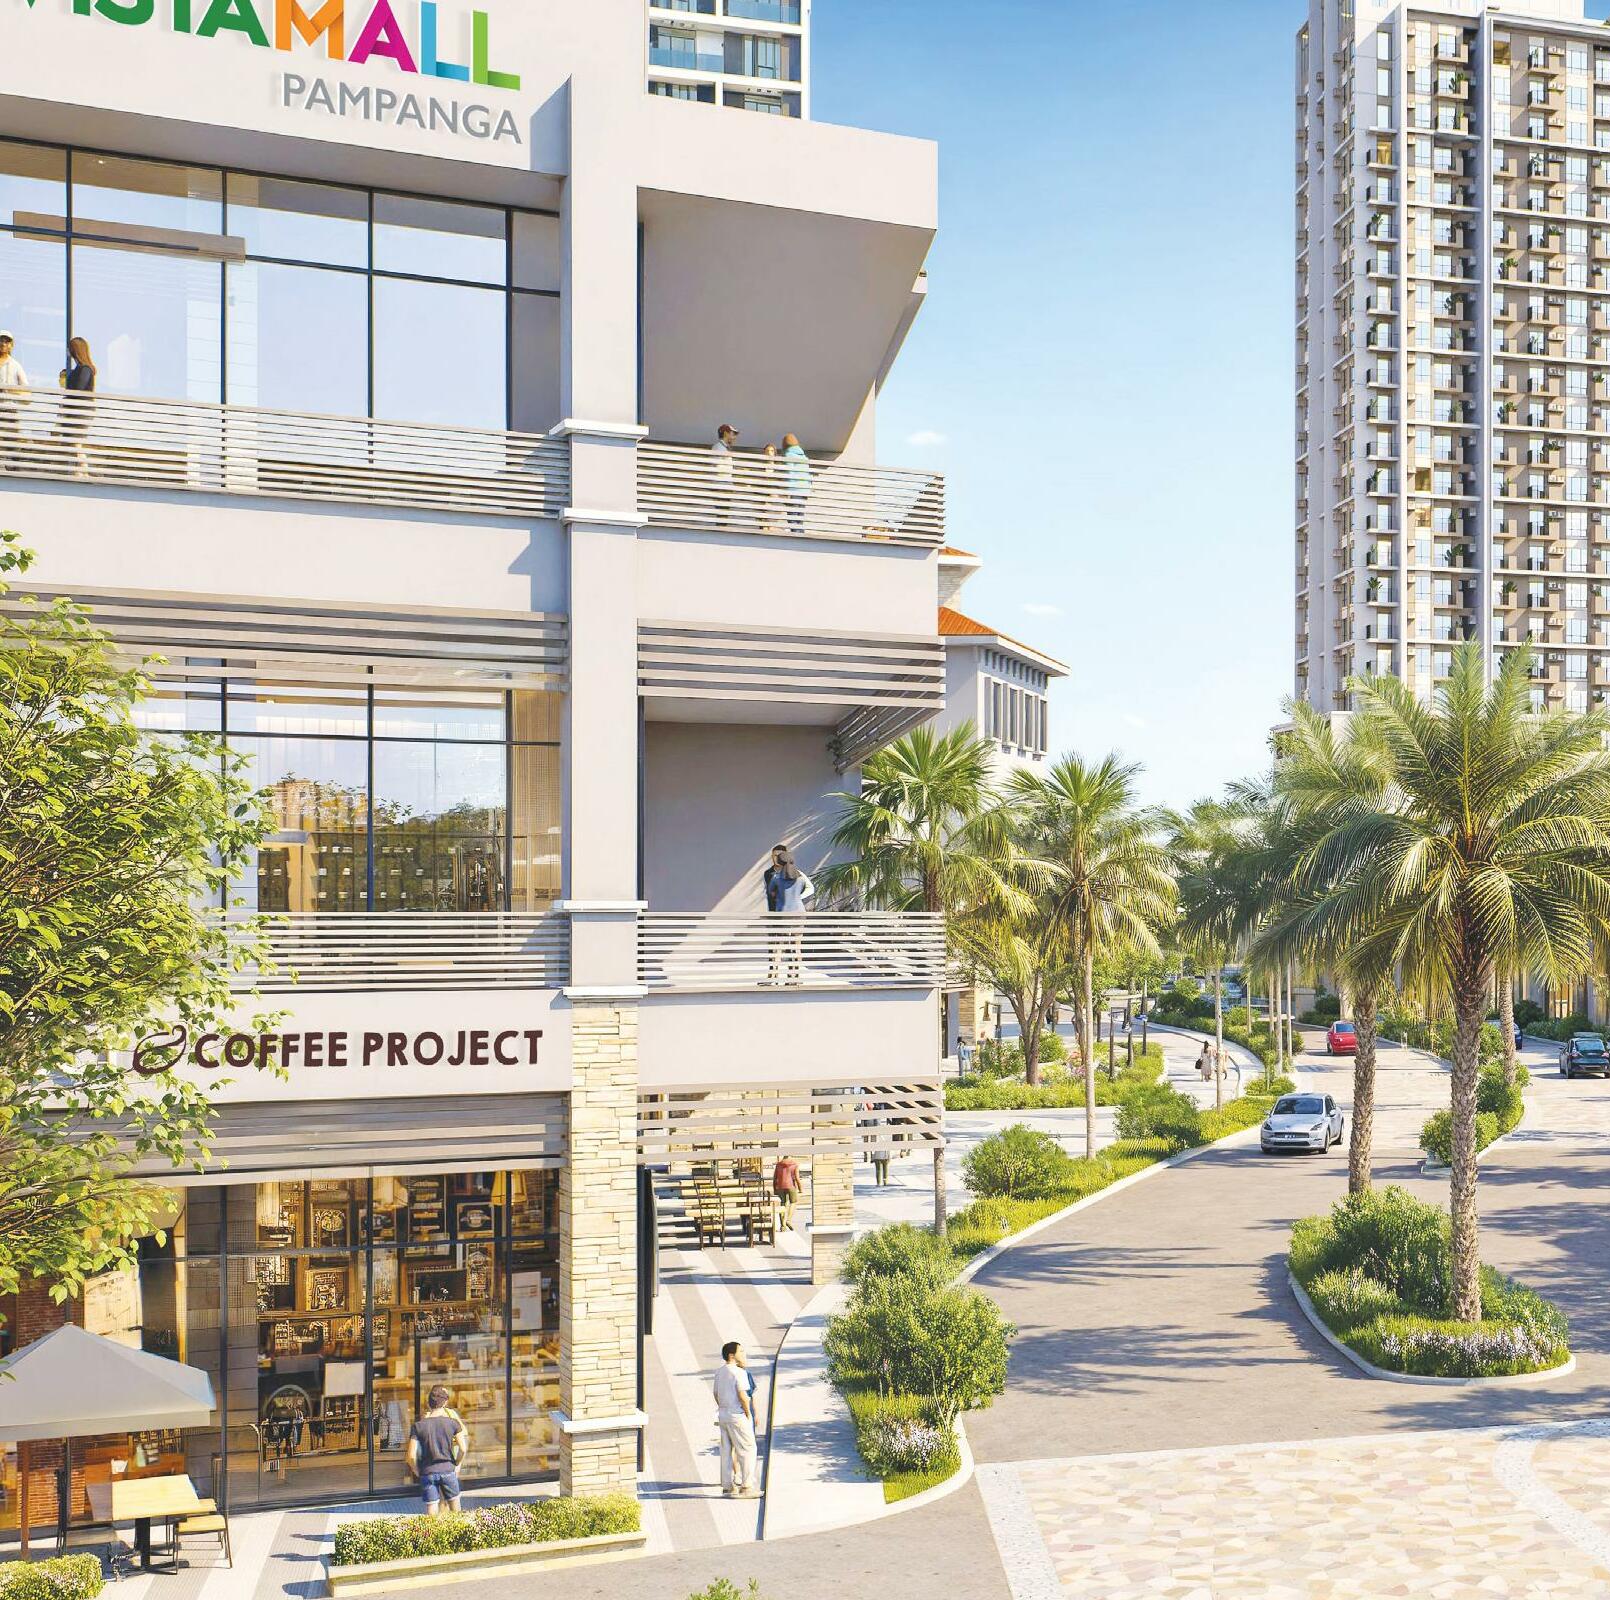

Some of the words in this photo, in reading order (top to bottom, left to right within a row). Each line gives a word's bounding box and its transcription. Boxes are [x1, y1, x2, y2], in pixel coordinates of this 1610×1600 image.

[24, 0, 521, 91] AMALL
[282, 72, 522, 145] PAMPANGA
[194, 1032, 347, 1069] COFFEE
[362, 1029, 544, 1067] PROJECT
